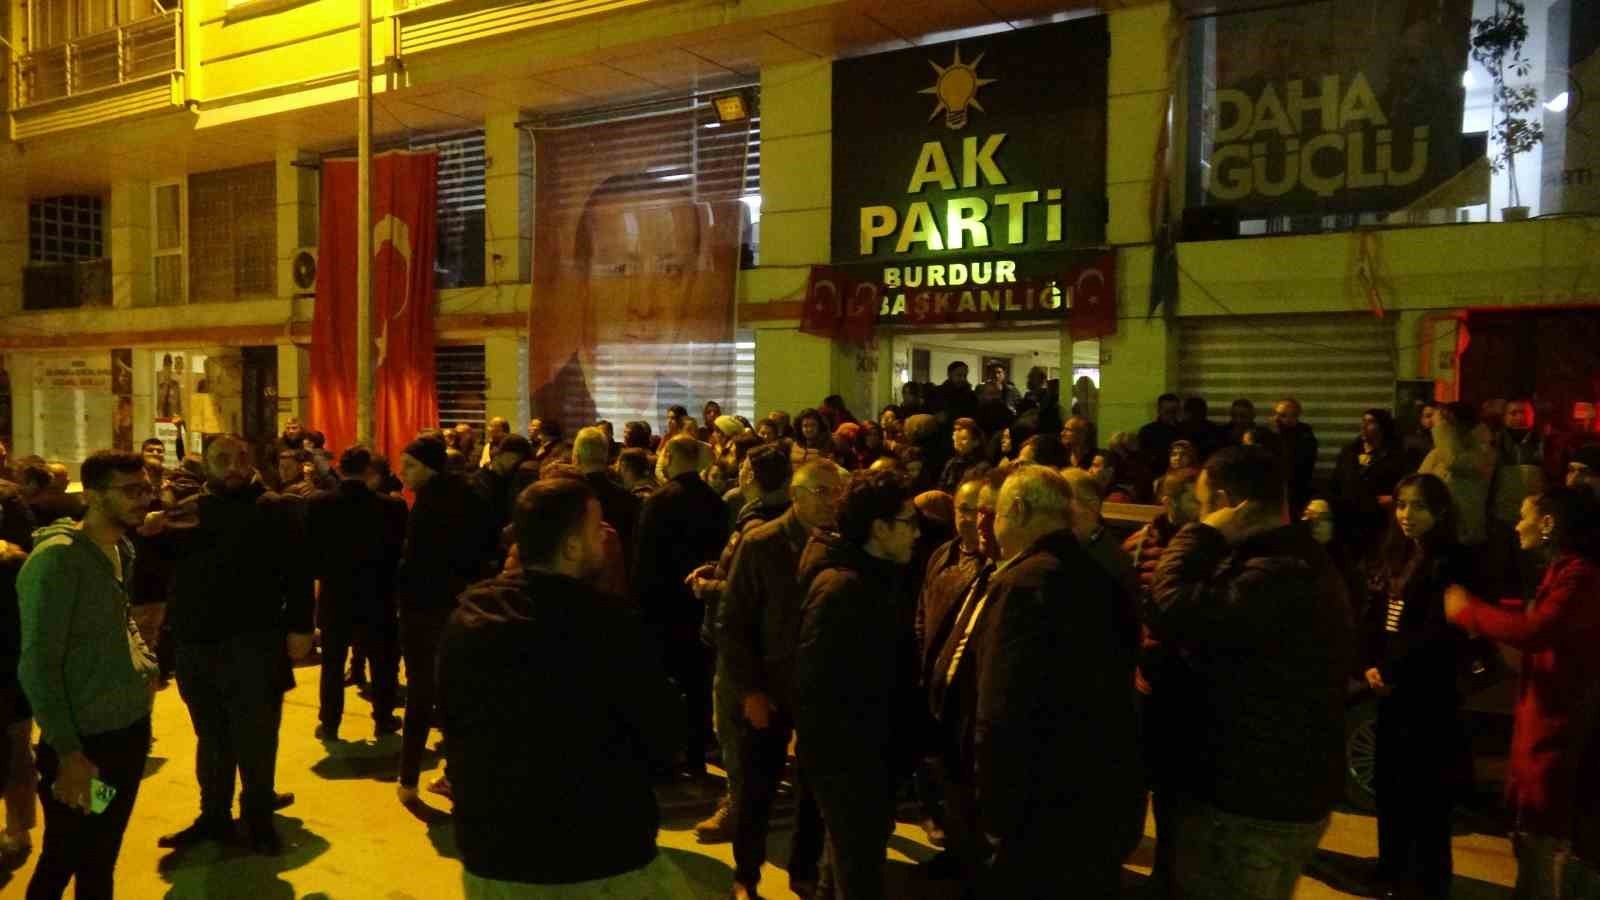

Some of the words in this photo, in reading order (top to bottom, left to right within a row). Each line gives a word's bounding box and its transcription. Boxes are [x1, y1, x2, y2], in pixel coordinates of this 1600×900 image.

[1208, 72, 1388, 142] DAHA
[907, 133, 1008, 193] AK
[884, 260, 1017, 288] BURDUR
